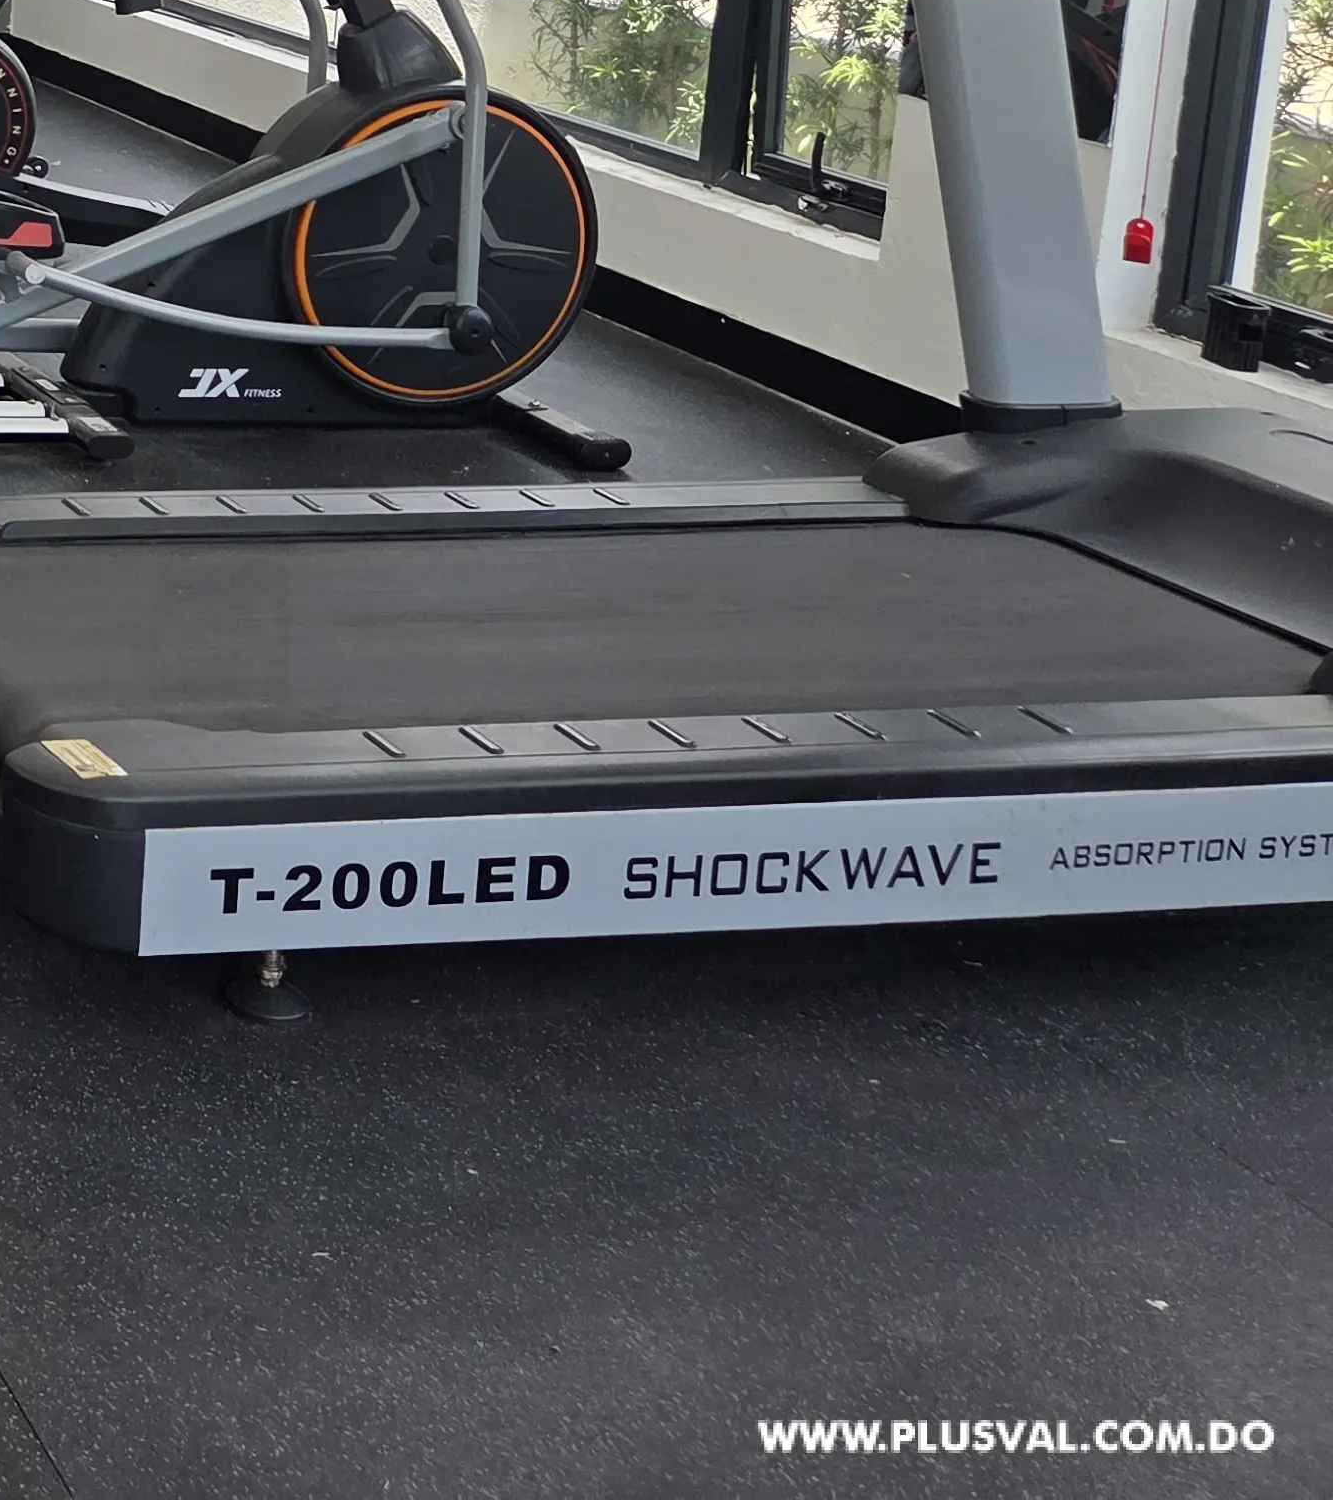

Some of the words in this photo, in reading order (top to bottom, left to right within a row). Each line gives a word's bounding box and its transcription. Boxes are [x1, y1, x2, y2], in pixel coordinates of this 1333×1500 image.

[178, 368, 249, 397] JX
[244, 388, 282, 398] FITNESS
[209, 854, 571, 915] T-200LED
[623, 841, 1002, 900] SHOCKWAVE
[1049, 837, 1247, 870] ABSORPTION
